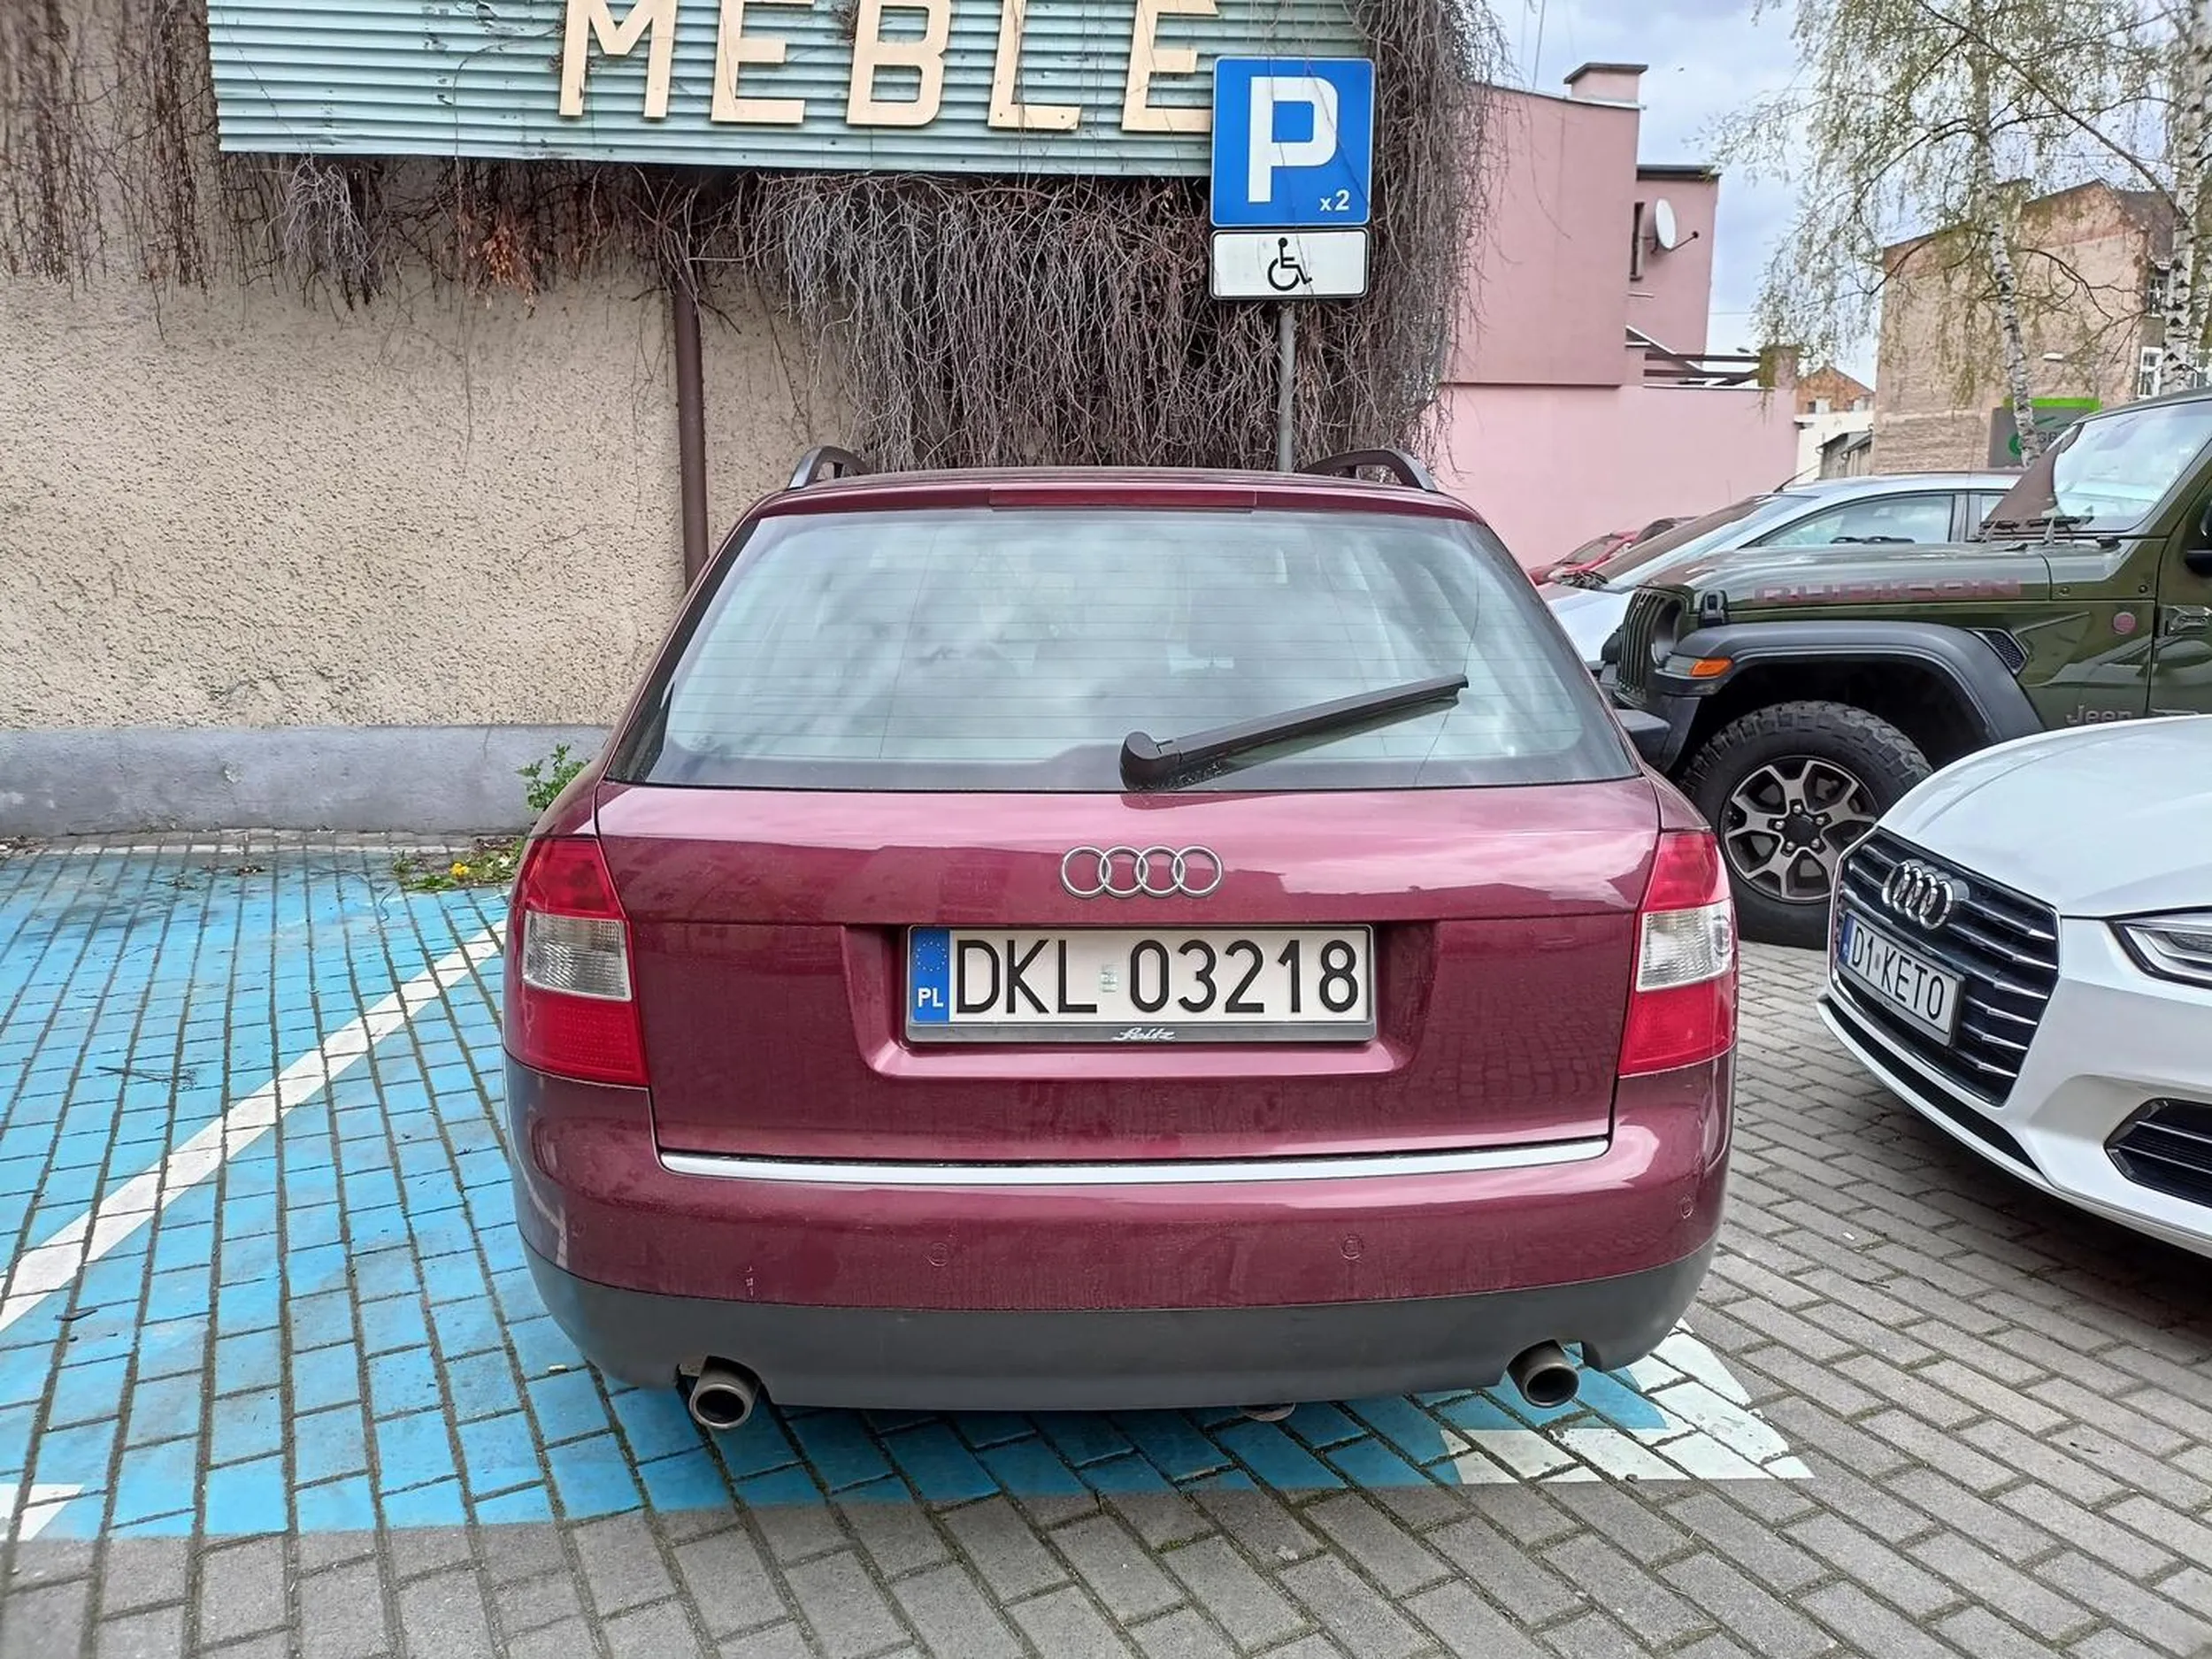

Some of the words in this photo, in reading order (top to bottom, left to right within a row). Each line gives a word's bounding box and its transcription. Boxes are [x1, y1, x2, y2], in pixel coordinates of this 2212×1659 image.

[559, 0, 1218, 132] MEBLE
[1248, 76, 1338, 203] P
[1319, 189, 1350, 211] x2
[918, 987, 944, 1007] PL
[956, 940, 1097, 1013] DKL
[1130, 940, 1358, 1013] 03218
[1881, 946, 1944, 1020] KETO
